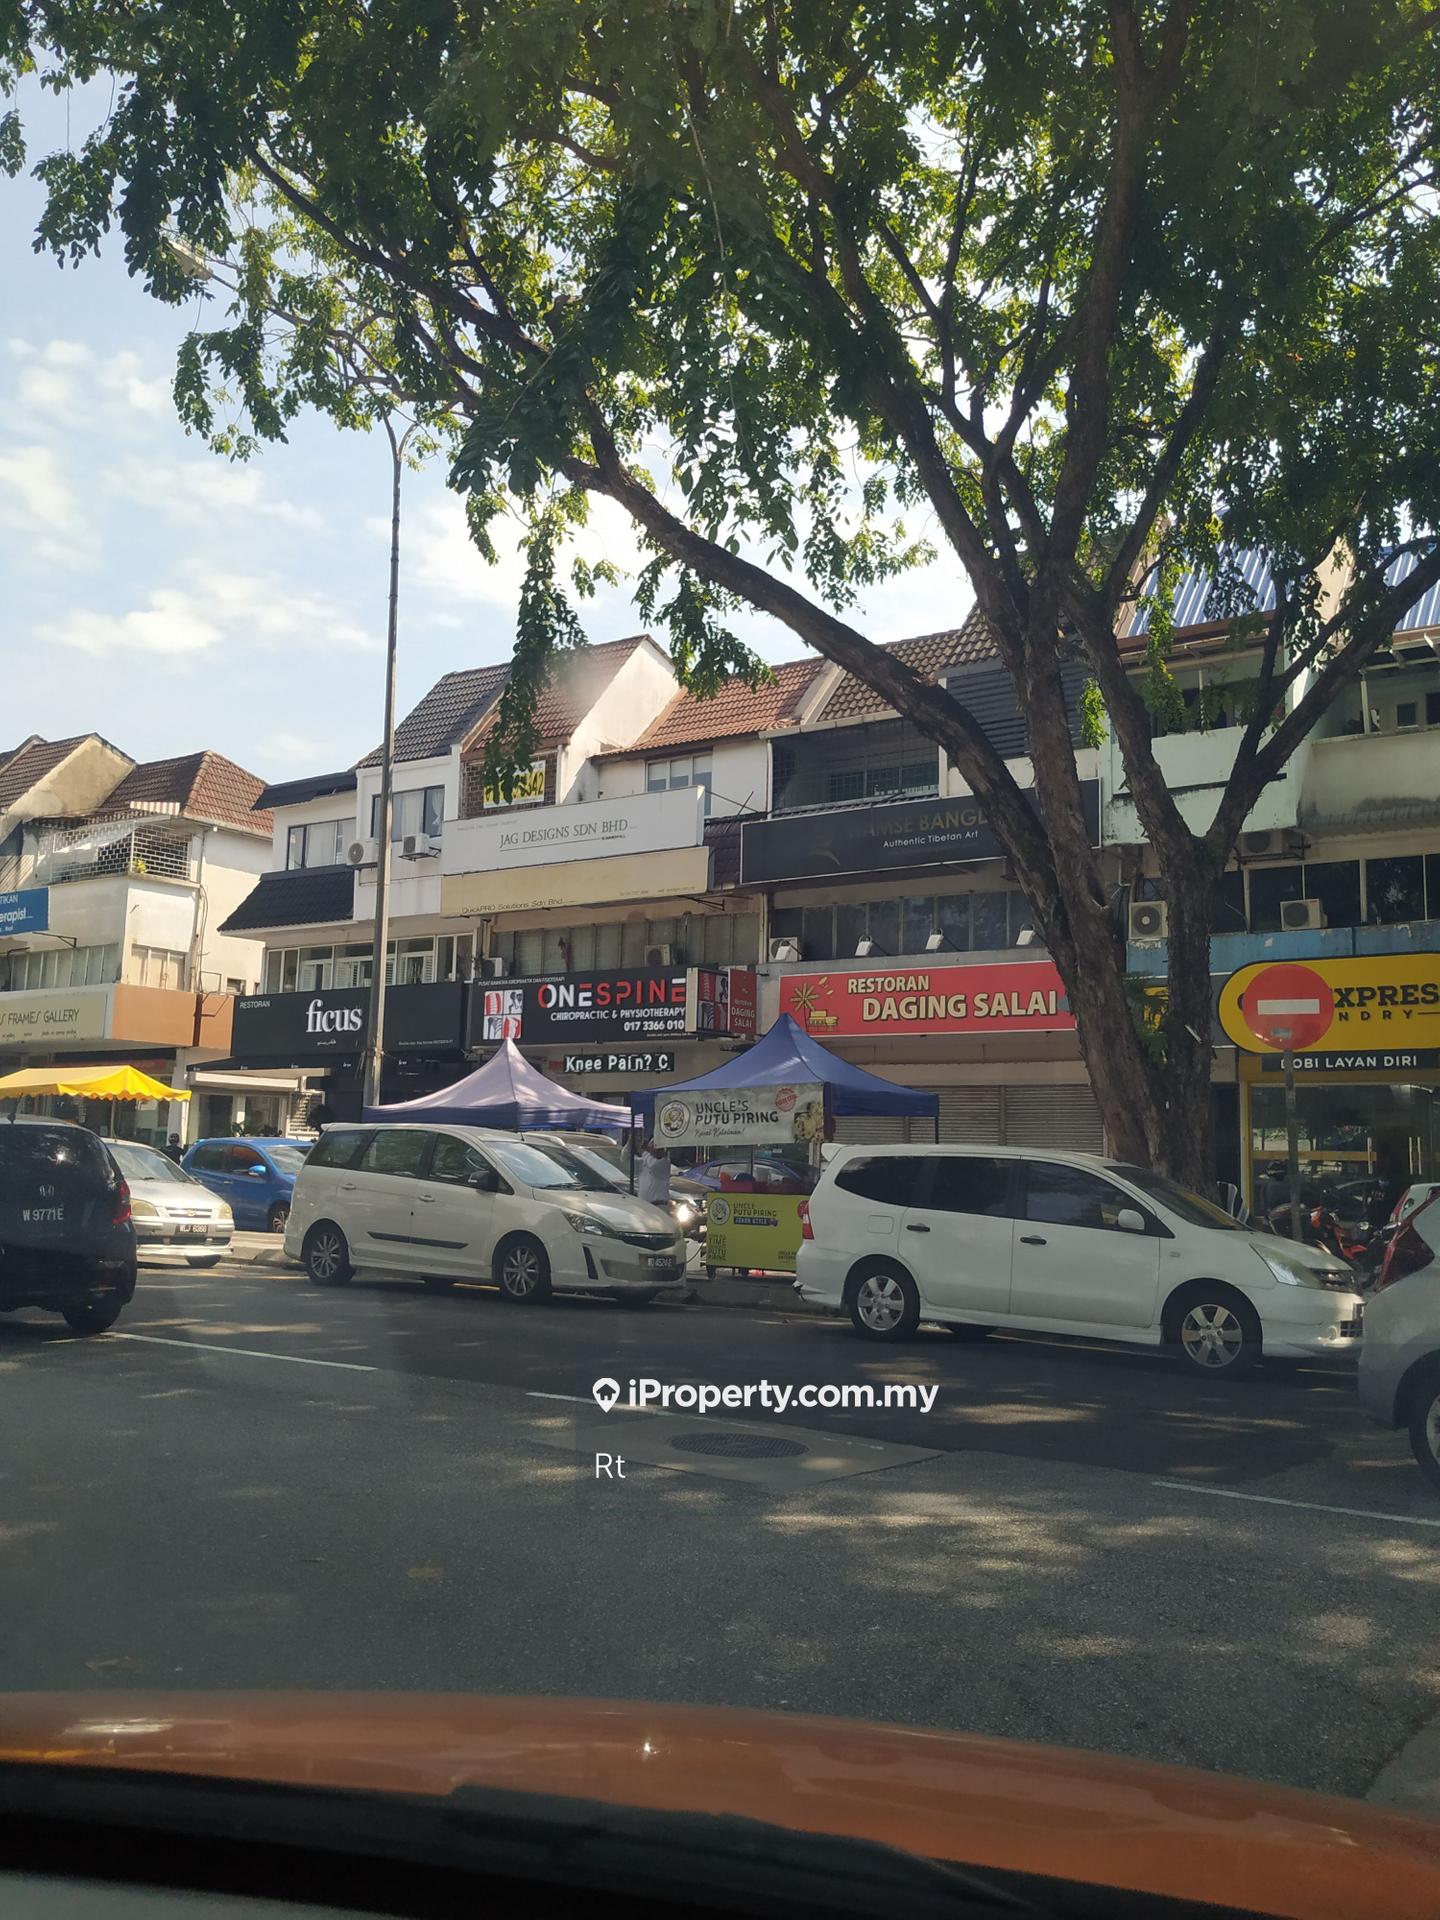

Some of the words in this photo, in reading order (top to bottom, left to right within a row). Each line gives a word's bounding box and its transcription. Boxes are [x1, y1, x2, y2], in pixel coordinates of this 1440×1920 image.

[919, 808, 988, 831] BANGL
[499, 833, 519, 848] JAG
[523, 826, 570, 843] DESIGNS
[574, 822, 598, 836] SDN
[602, 819, 628, 834] BHD
[883, 836, 926, 848] Authentic
[928, 831, 962, 843] Tibetan
[965, 830, 978, 839] Art
[848, 975, 930, 994] RESTORAN
[537, 977, 686, 1009] ONESPINE
[1331, 983, 1440, 1009] XPRES
[240, 1000, 271, 1009] RESTORAN
[731, 1006, 755, 1018] DAGING
[863, 994, 968, 1021] DAGING
[973, 990, 1057, 1017] SALAI
[8, 1010, 42, 1025] FRAMES
[43, 1008, 80, 1023] GALLERY
[305, 998, 362, 1033] ficus
[550, 1010, 610, 1022] CHIROPRACTIC
[611, 1009, 618, 1019] &
[620, 1007, 686, 1019] PHYSIOTHERAPY
[623, 1021, 641, 1032] 017
[642, 1020, 665, 1031] 3366
[666, 1019, 685, 1030] 010
[734, 1018, 752, 1028] SALAI
[565, 1055, 602, 1072] Knee
[608, 1054, 652, 1071] Pain?
[658, 1054, 668, 1069] C
[1325, 1055, 1377, 1068] LAYAN
[1383, 1055, 1417, 1067] DIRI
[695, 1100, 749, 1114] UNCLE'S
[694, 1112, 730, 1126] PUTU
[733, 1110, 779, 1124] PIRING
[23, 1209, 31, 1221] W
[733, 1208, 752, 1216] PUTU
[753, 1209, 777, 1217] PIRING
